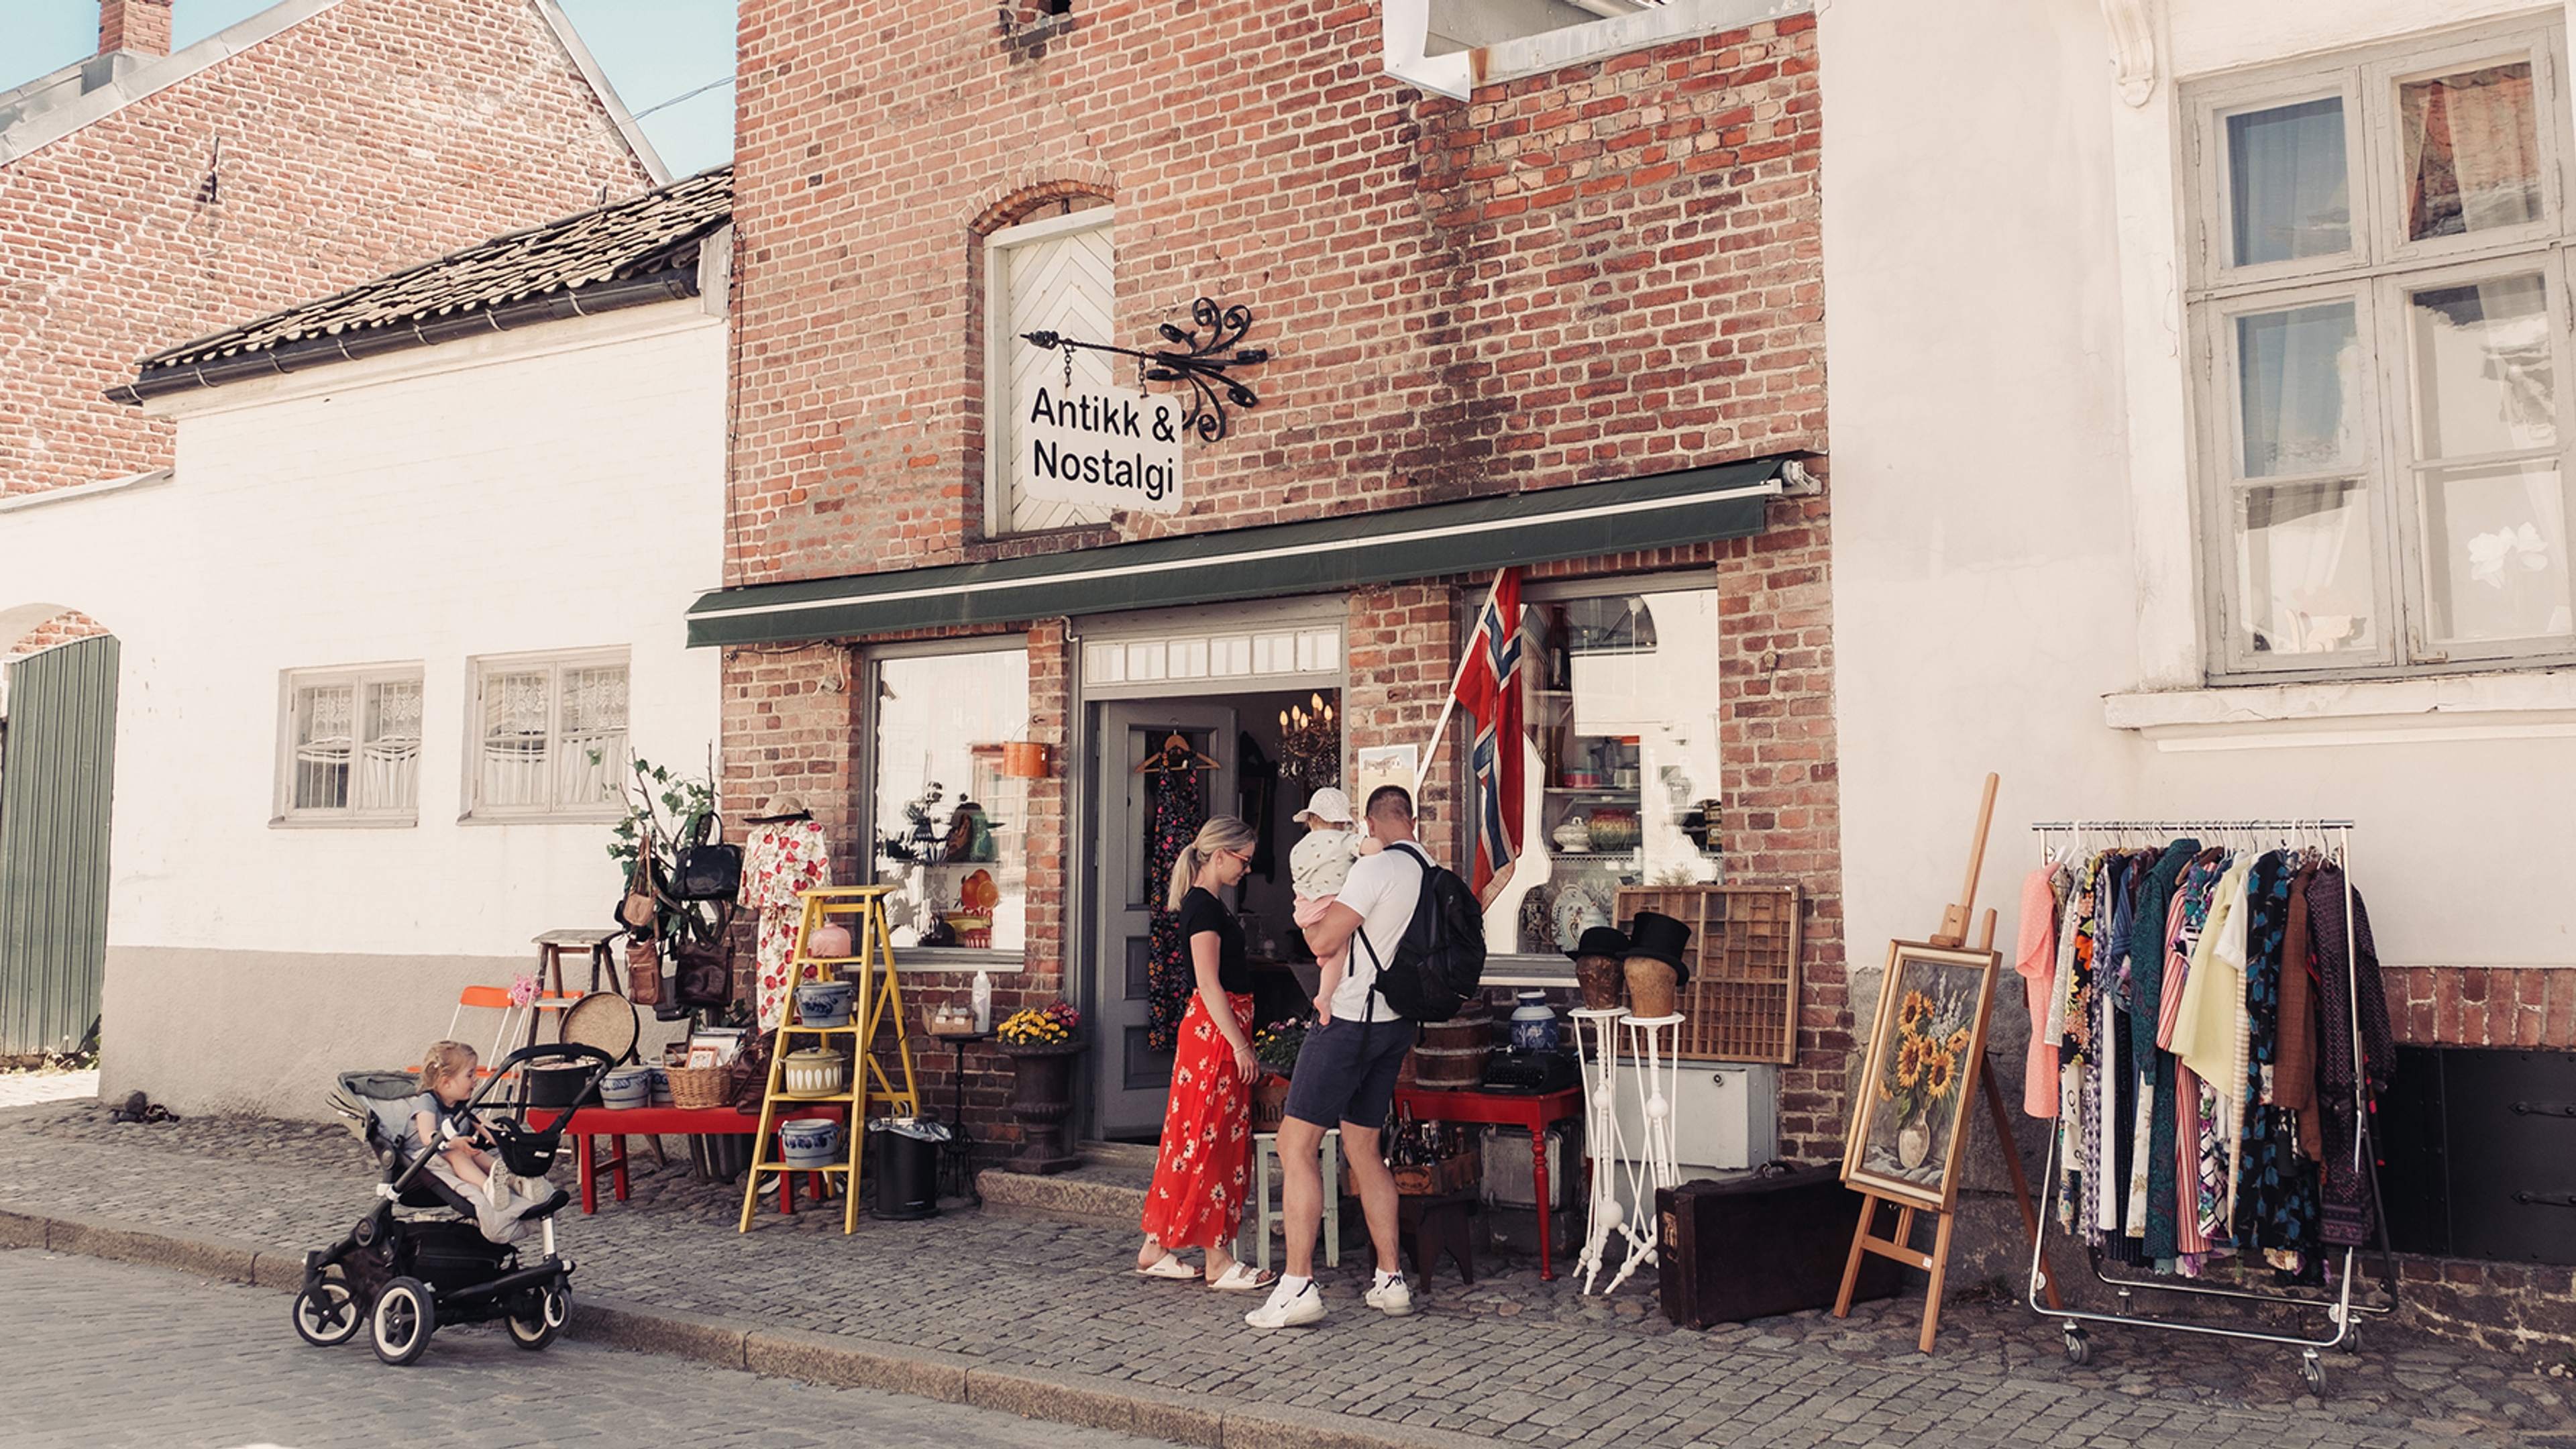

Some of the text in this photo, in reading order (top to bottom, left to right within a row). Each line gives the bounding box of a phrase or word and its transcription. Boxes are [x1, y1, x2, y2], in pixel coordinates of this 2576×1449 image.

[1031, 387, 1175, 443] Antikk &
[1034, 439, 1173, 500] Nostalgi
